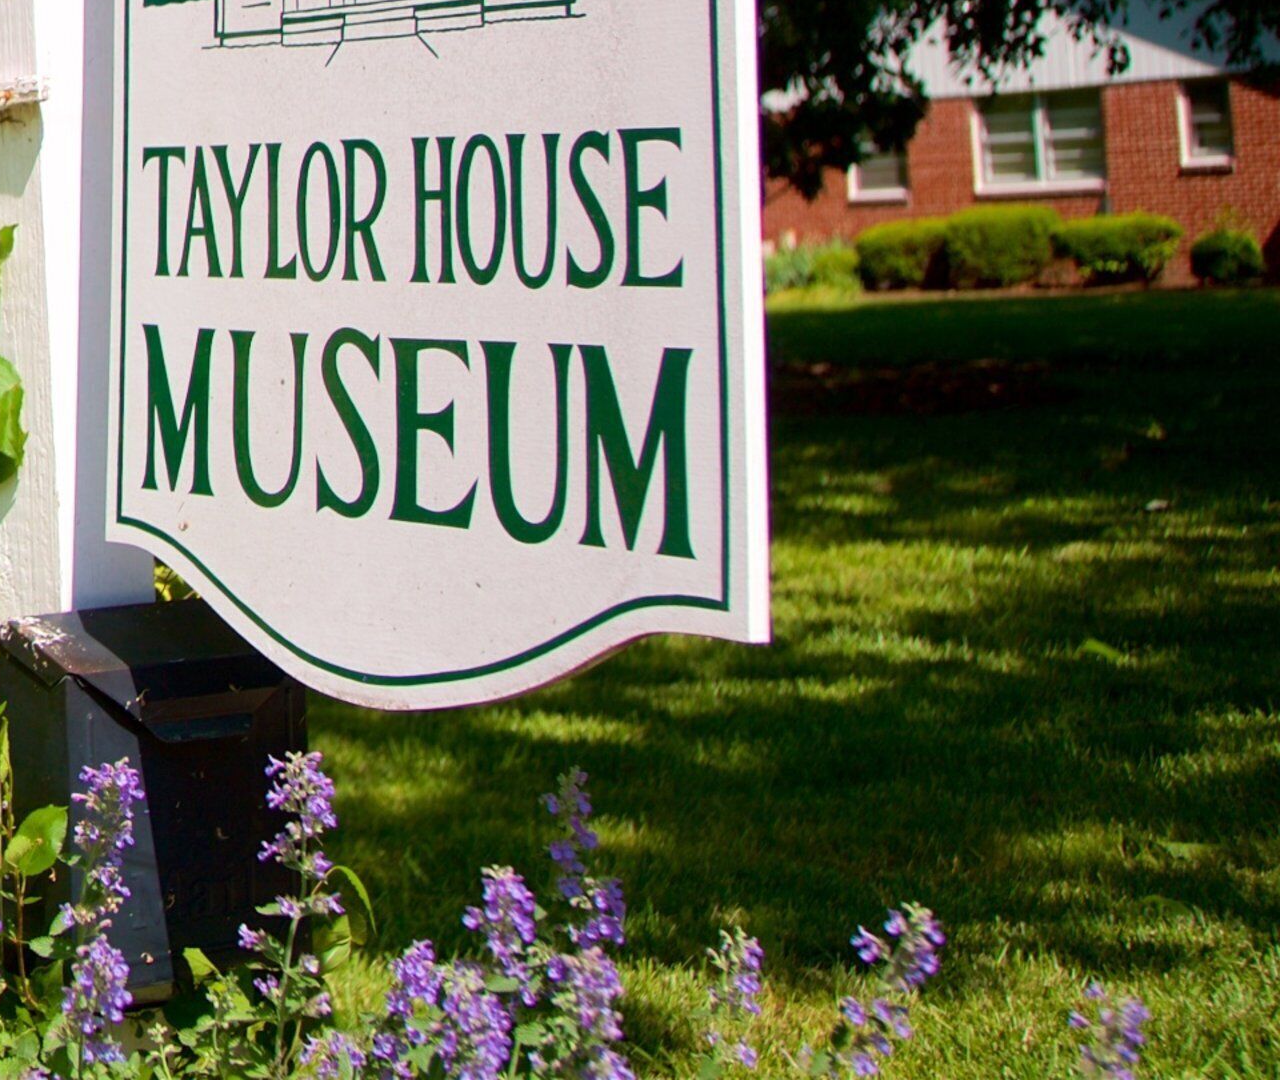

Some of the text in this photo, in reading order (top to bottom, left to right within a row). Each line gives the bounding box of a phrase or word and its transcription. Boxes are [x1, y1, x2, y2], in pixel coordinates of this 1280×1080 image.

[143, 127, 683, 289] TAYLOR HOUSE
[141, 323, 697, 560] MUSEUM
